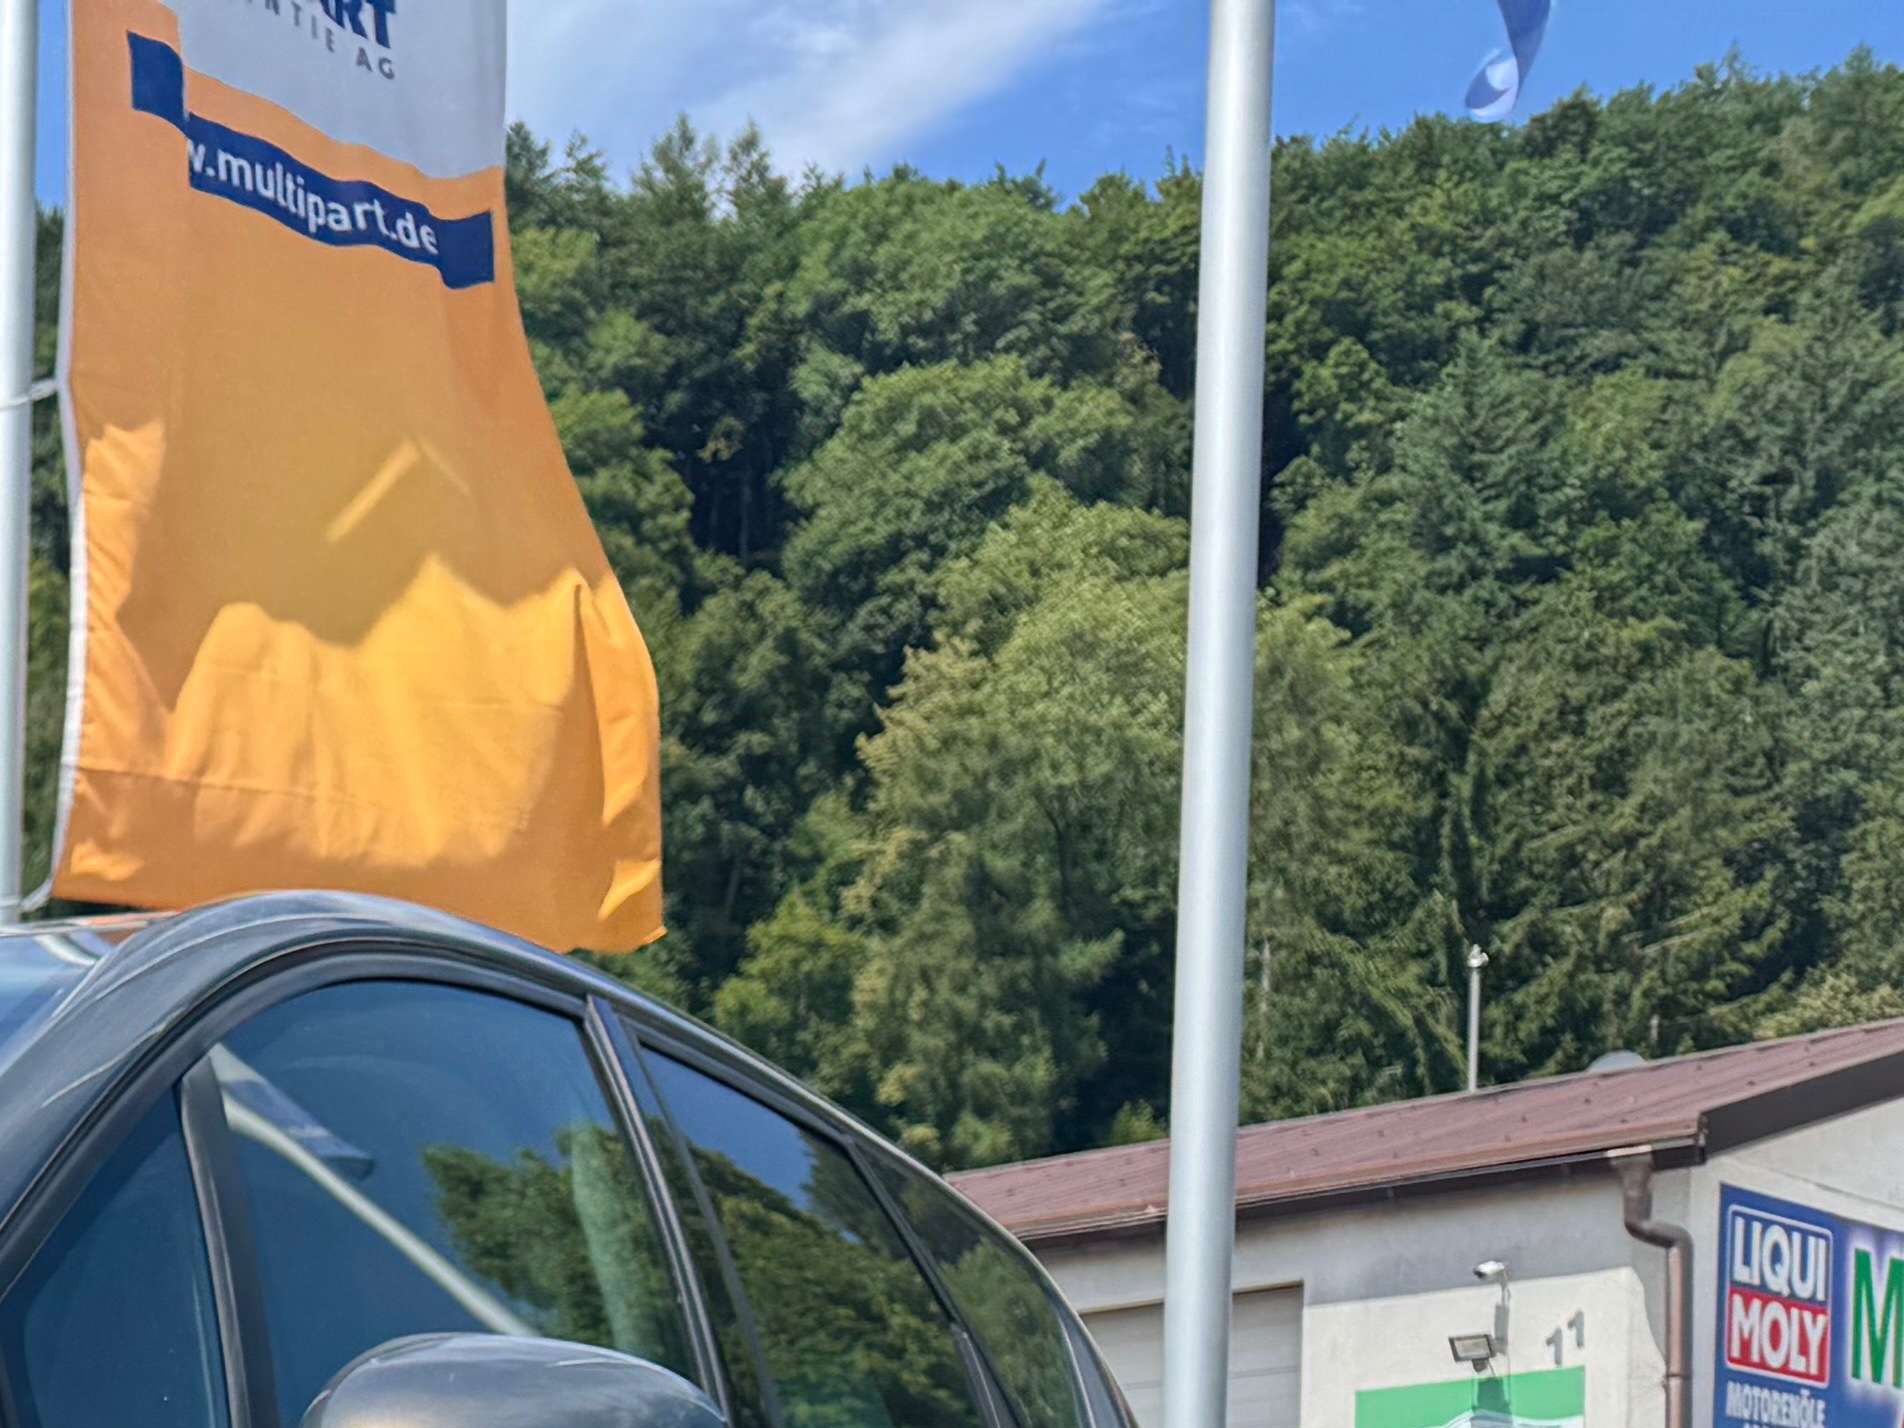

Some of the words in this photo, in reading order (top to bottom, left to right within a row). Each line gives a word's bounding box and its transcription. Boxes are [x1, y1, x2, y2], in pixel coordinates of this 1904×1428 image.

[355, 47, 396, 80] AG
[1733, 1217, 1827, 1301] LIQUI
[1545, 1308, 1584, 1367] 11
[1730, 1293, 1828, 1376] MOLY
